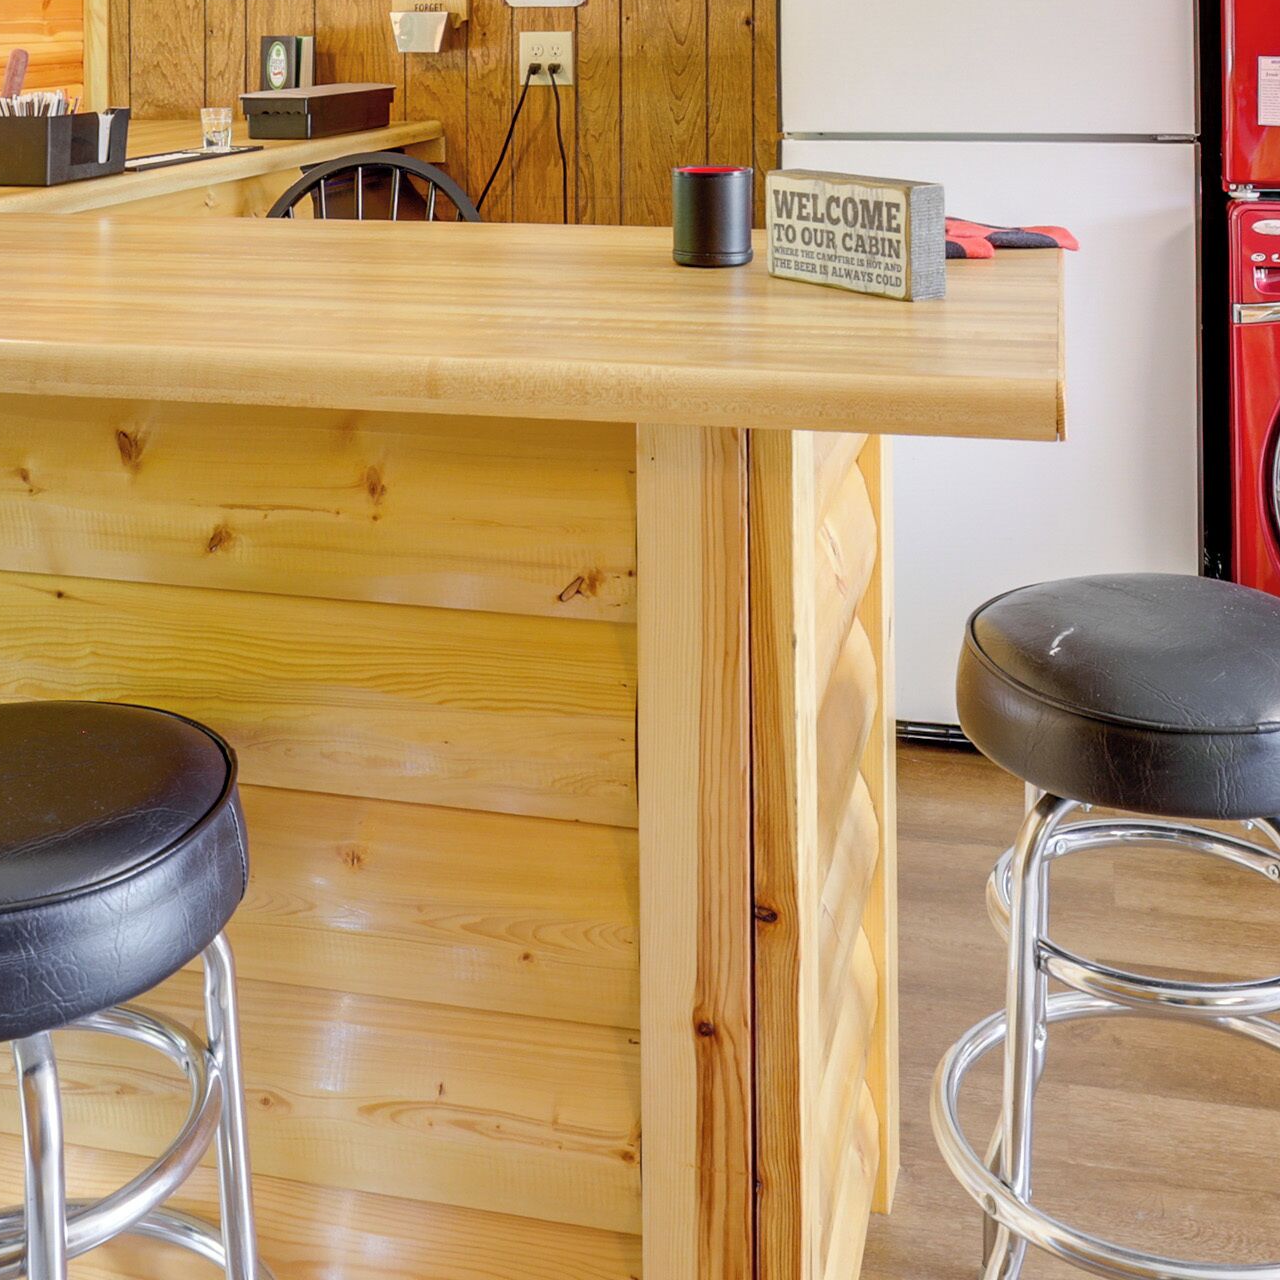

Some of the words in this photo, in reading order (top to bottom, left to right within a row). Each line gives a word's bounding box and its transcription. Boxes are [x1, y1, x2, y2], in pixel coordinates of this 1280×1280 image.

[414, 3, 443, 12] FORGET
[773, 189, 901, 234] WELCOME
[774, 223, 796, 244] TO
[801, 227, 837, 250] OUR
[841, 232, 901, 259] CABIN
[774, 246, 799, 257] WHERE
[801, 249, 815, 259] THE
[817, 252, 855, 266] CAMPFIRE
[857, 257, 865, 267] IS
[866, 258, 882, 269] HOT
[884, 262, 902, 273] AND
[774, 258, 793, 270] THE
[794, 261, 818, 274] BEER
[820, 265, 829, 275] IS
[832, 267, 874, 283] ALWAYS
[876, 274, 902, 288] COLD
